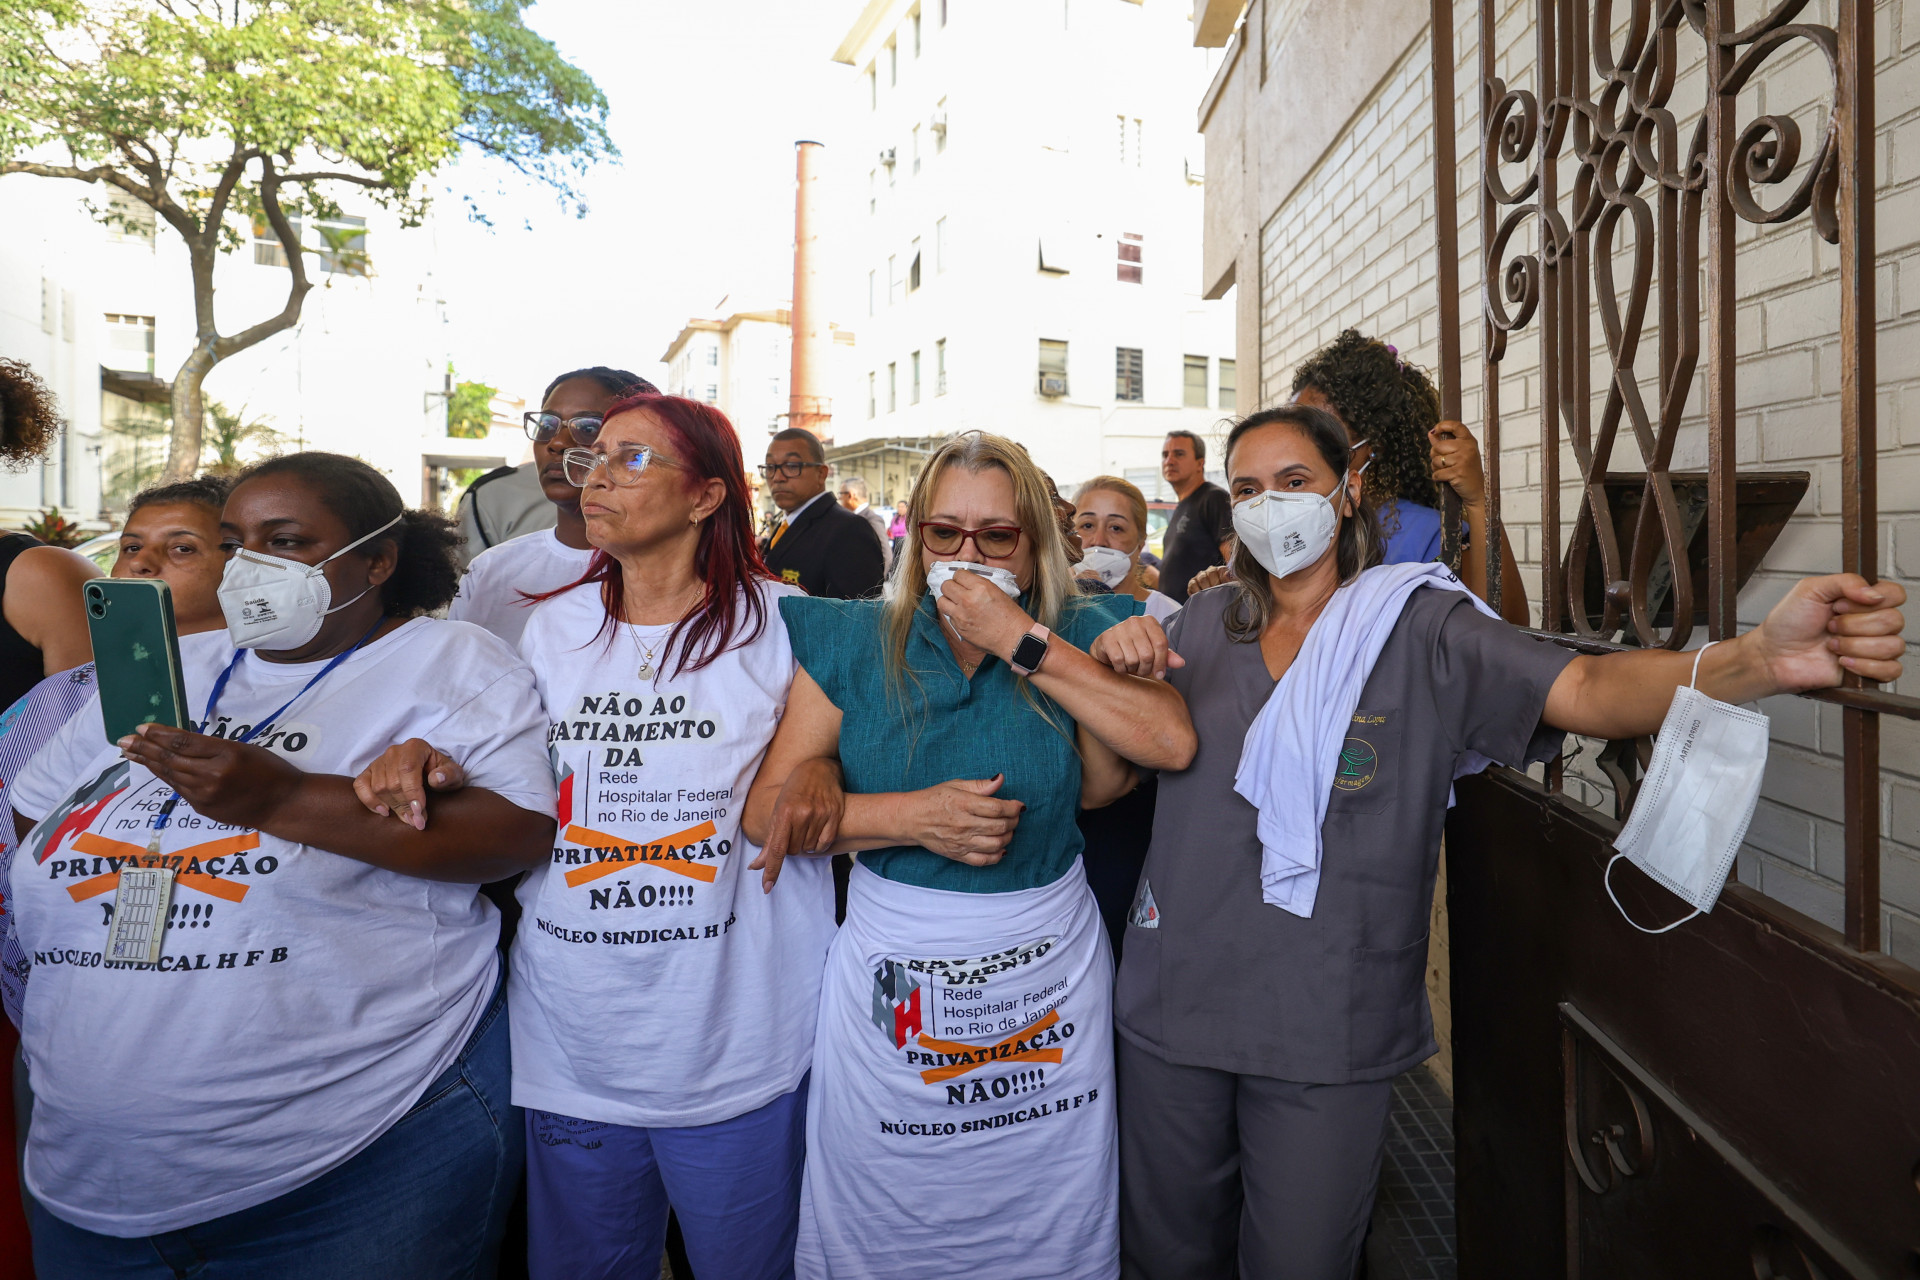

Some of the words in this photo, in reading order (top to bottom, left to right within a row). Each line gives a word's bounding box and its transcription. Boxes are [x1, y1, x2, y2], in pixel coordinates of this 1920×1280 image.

[579, 692, 643, 716] NÃO
[650, 695, 686, 716] AO
[603, 748, 643, 767] DA
[599, 771, 638, 784] Rede
[598, 790, 673, 806] Hospitalar
[677, 787, 733, 801] Federal
[115, 819, 140, 830] no
[178, 814, 201, 828] de
[598, 811, 617, 823] no
[621, 809, 646, 822] Rio
[650, 808, 669, 822] de
[673, 807, 727, 822] Janeiro
[553, 838, 732, 864] PRIVATIZAÇÃO
[49, 852, 279, 880] PRIVATIZAÇÃO
[589, 881, 694, 910] NÃO!!!!
[536, 917, 597, 944] NÚCLEO
[602, 926, 699, 945] SINDICAL
[704, 923, 719, 938] H
[34, 947, 102, 968] NÚCLEO
[216, 953, 236, 969] H
[244, 949, 264, 967] F
[269, 946, 289, 963] B
[943, 989, 983, 1001] Rede
[943, 1000, 1019, 1021] Hospitalar
[1023, 976, 1068, 1007] Federal
[945, 1024, 964, 1036] no
[968, 1020, 993, 1035] Rio
[998, 1017, 1017, 1031] de
[1021, 994, 1068, 1026] Janeiro
[906, 1022, 1075, 1067] PRIVATIZAÇÃO
[945, 1068, 1046, 1106] NÃO!!!!
[566, 1119, 579, 1127] de
[880, 1119, 956, 1137] NÚCLEO
[960, 1104, 1052, 1134] SINDICAL
[1055, 1098, 1069, 1112] H
[1072, 1095, 1084, 1109] F
[1087, 1089, 1099, 1103] B
